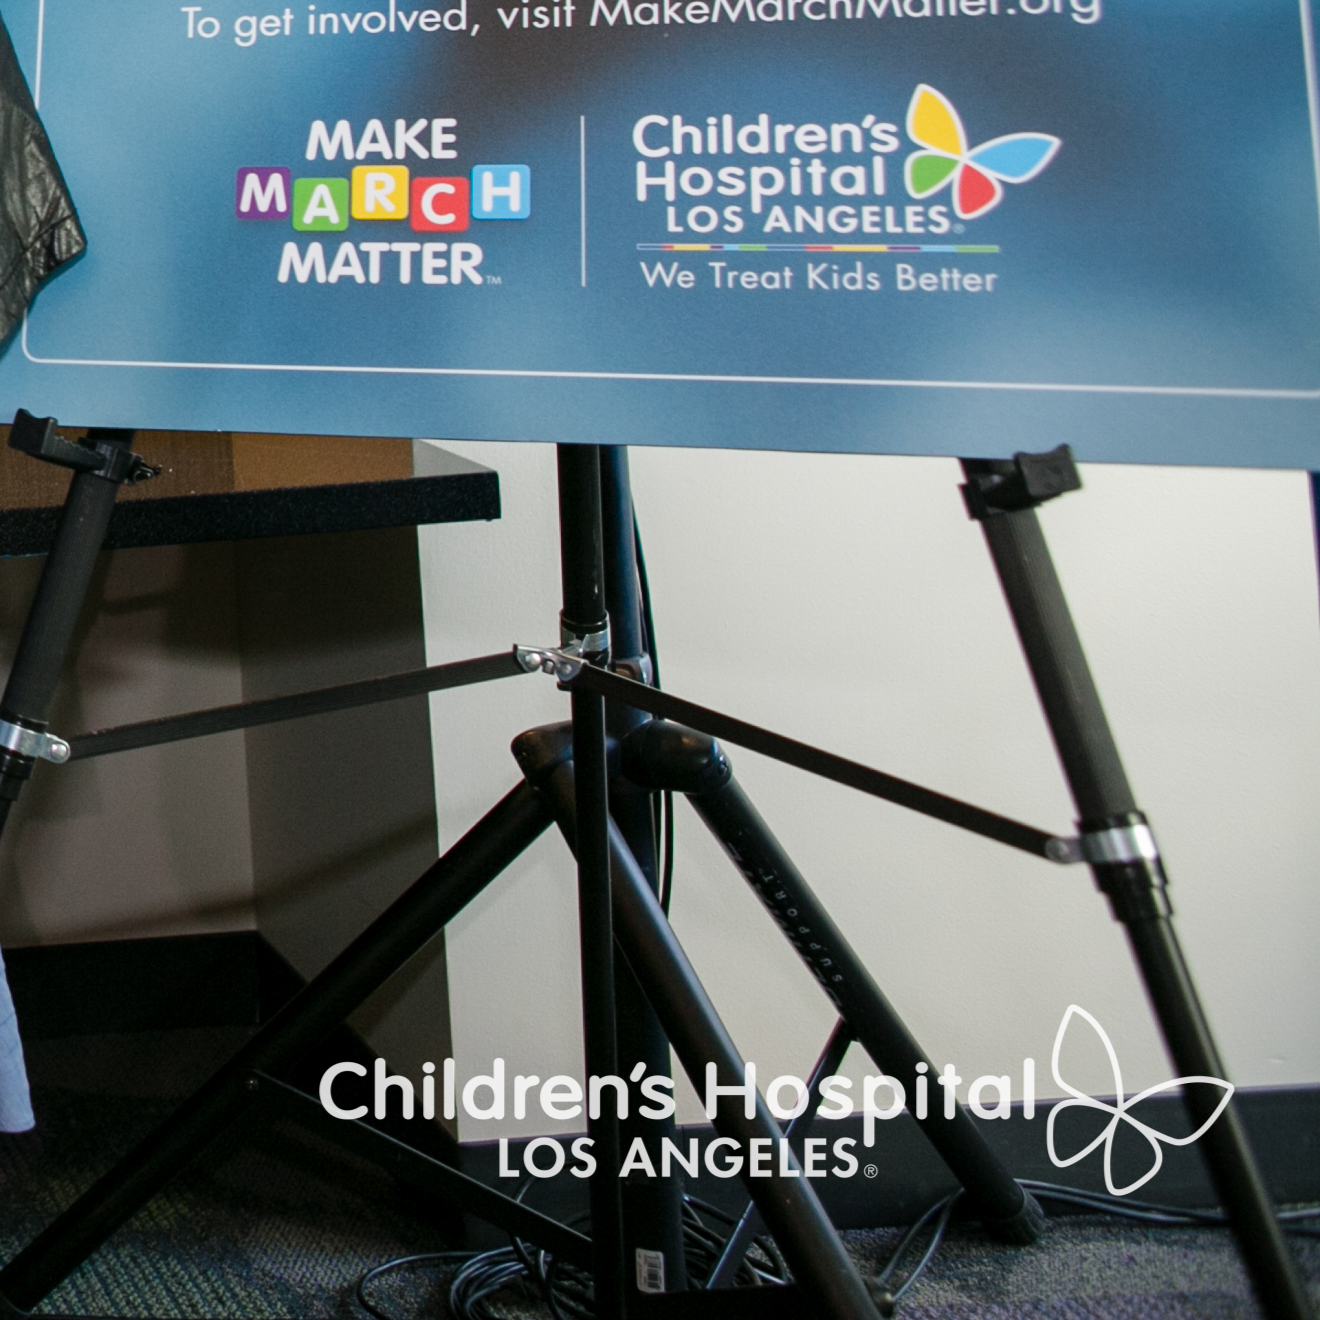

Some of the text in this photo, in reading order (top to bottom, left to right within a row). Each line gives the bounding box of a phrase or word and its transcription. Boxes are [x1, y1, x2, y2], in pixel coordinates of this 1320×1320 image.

[181, 7, 220, 38] To
[234, 8, 294, 47] get
[305, 118, 458, 160] MAKE
[632, 113, 900, 158] Children's
[239, 170, 522, 225] MARCH
[636, 155, 886, 213] Hospital
[666, 205, 745, 234] LOS
[640, 261, 998, 292] We Treat Kids Better
[762, 871, 843, 982] SUPPORT
